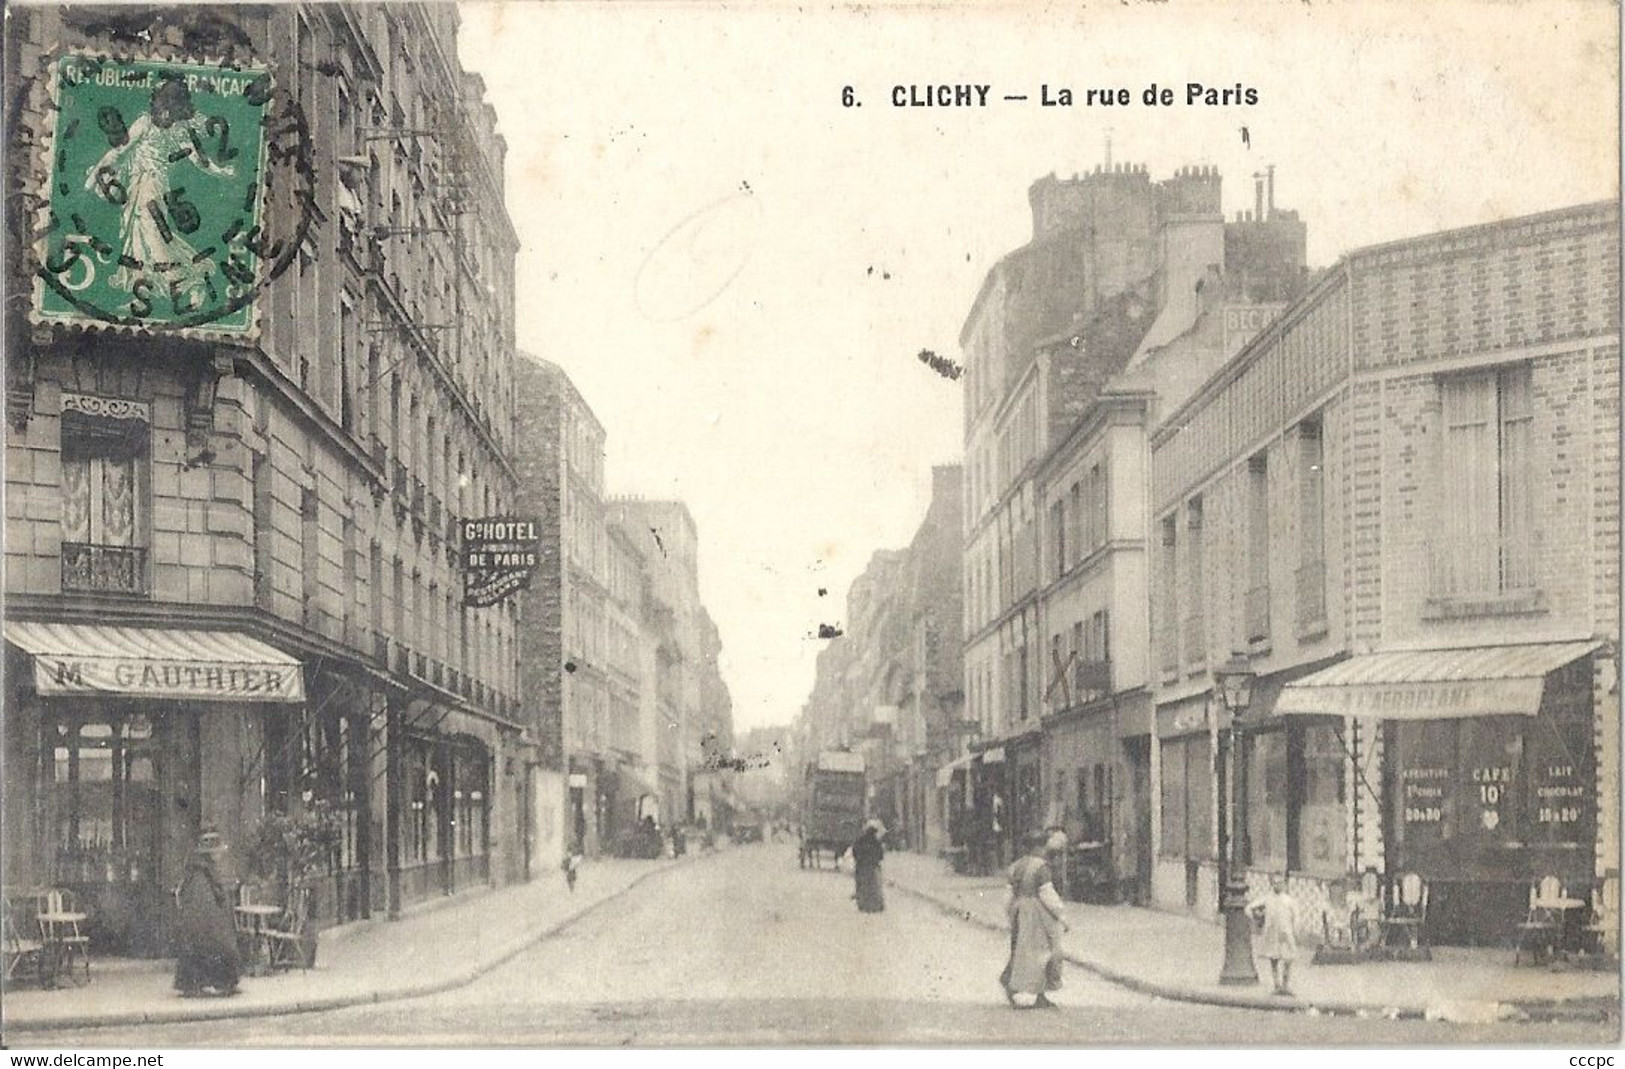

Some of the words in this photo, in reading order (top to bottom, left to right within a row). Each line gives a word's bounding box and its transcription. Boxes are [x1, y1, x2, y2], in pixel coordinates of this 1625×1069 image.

[483, 522, 539, 540] HOTEL
[469, 553, 488, 567] DE
[494, 553, 535, 567] PARIS
[114, 664, 282, 692] GAUTHIER
